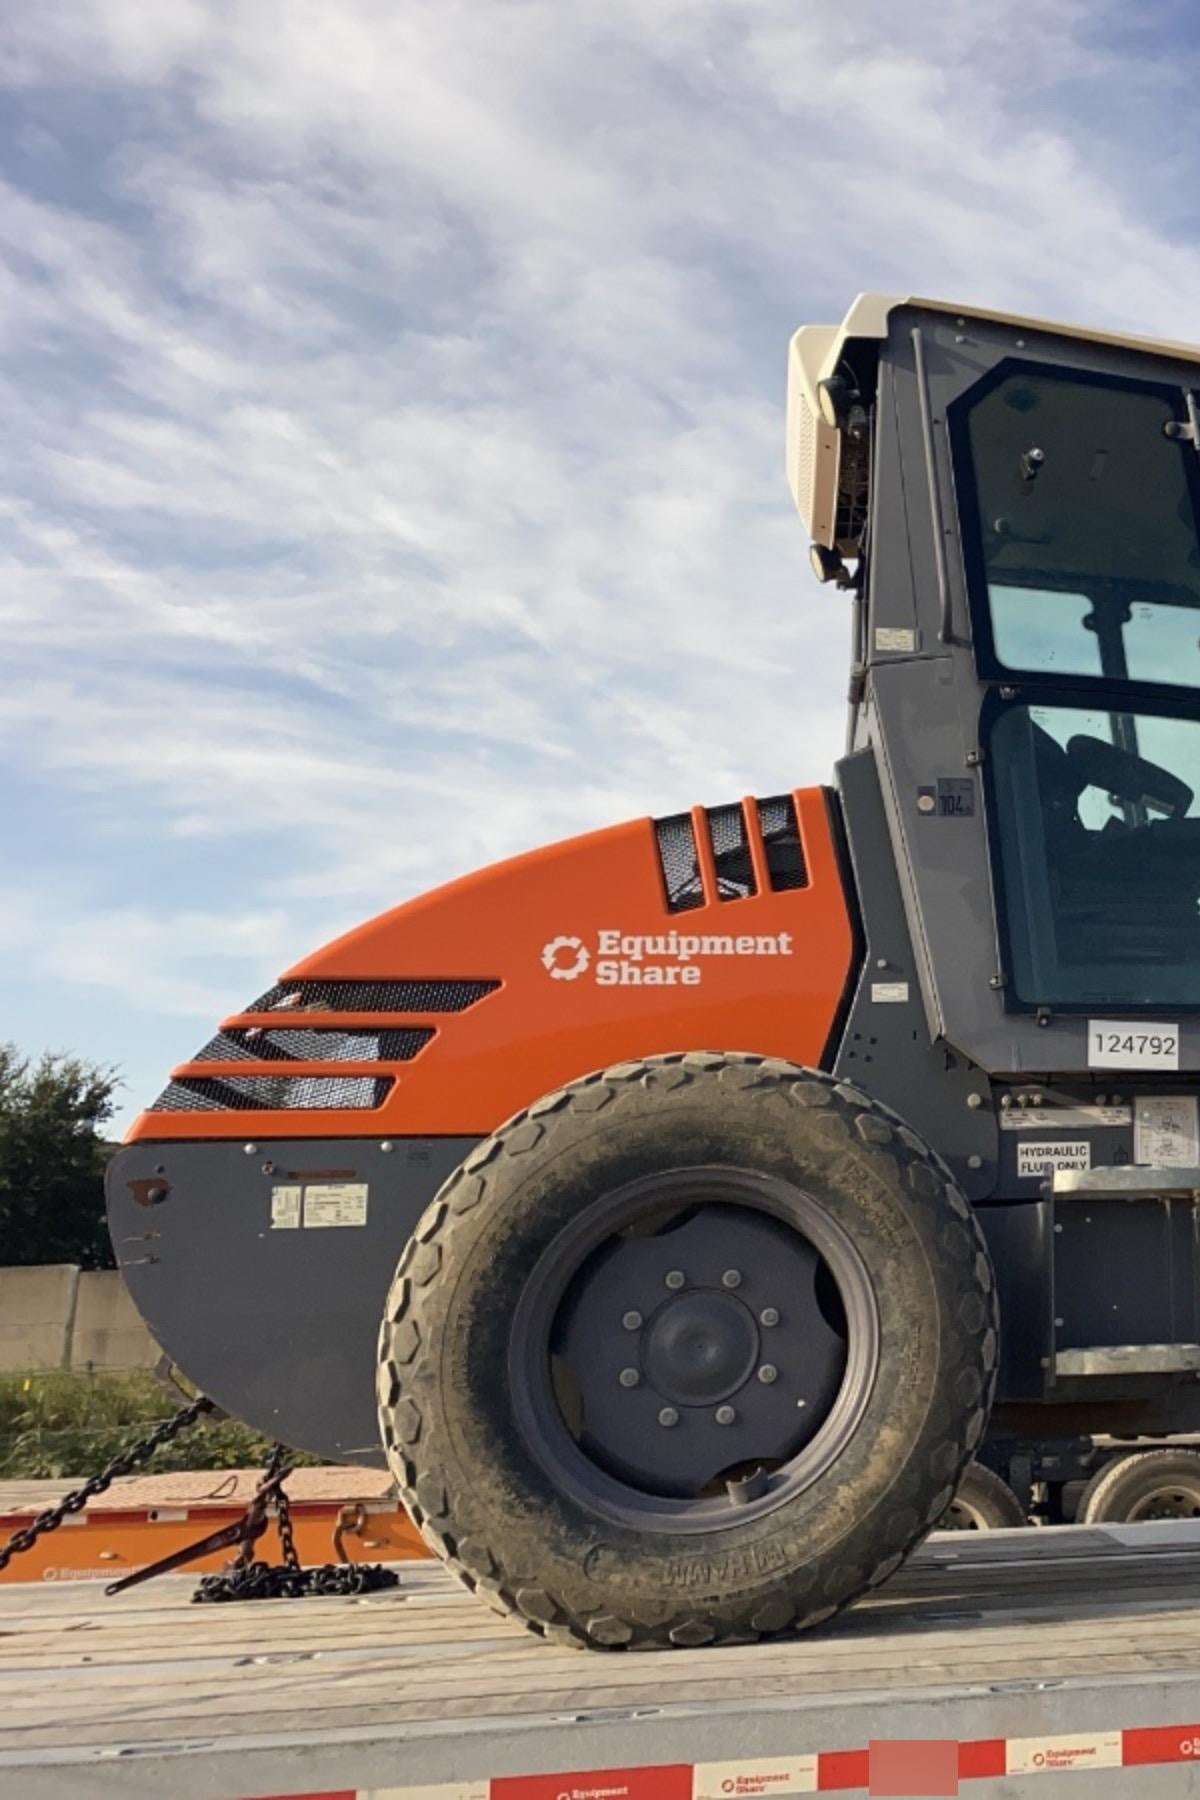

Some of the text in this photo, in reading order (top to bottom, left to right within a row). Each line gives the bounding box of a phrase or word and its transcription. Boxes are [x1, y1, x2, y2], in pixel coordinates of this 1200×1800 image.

[597, 930, 793, 960] Equipment
[596, 960, 701, 985] Share
[1096, 1033, 1176, 1056] 124792
[1020, 1145, 1088, 1158] HYDRAULIC
[1057, 1161, 1088, 1171] ONLY
